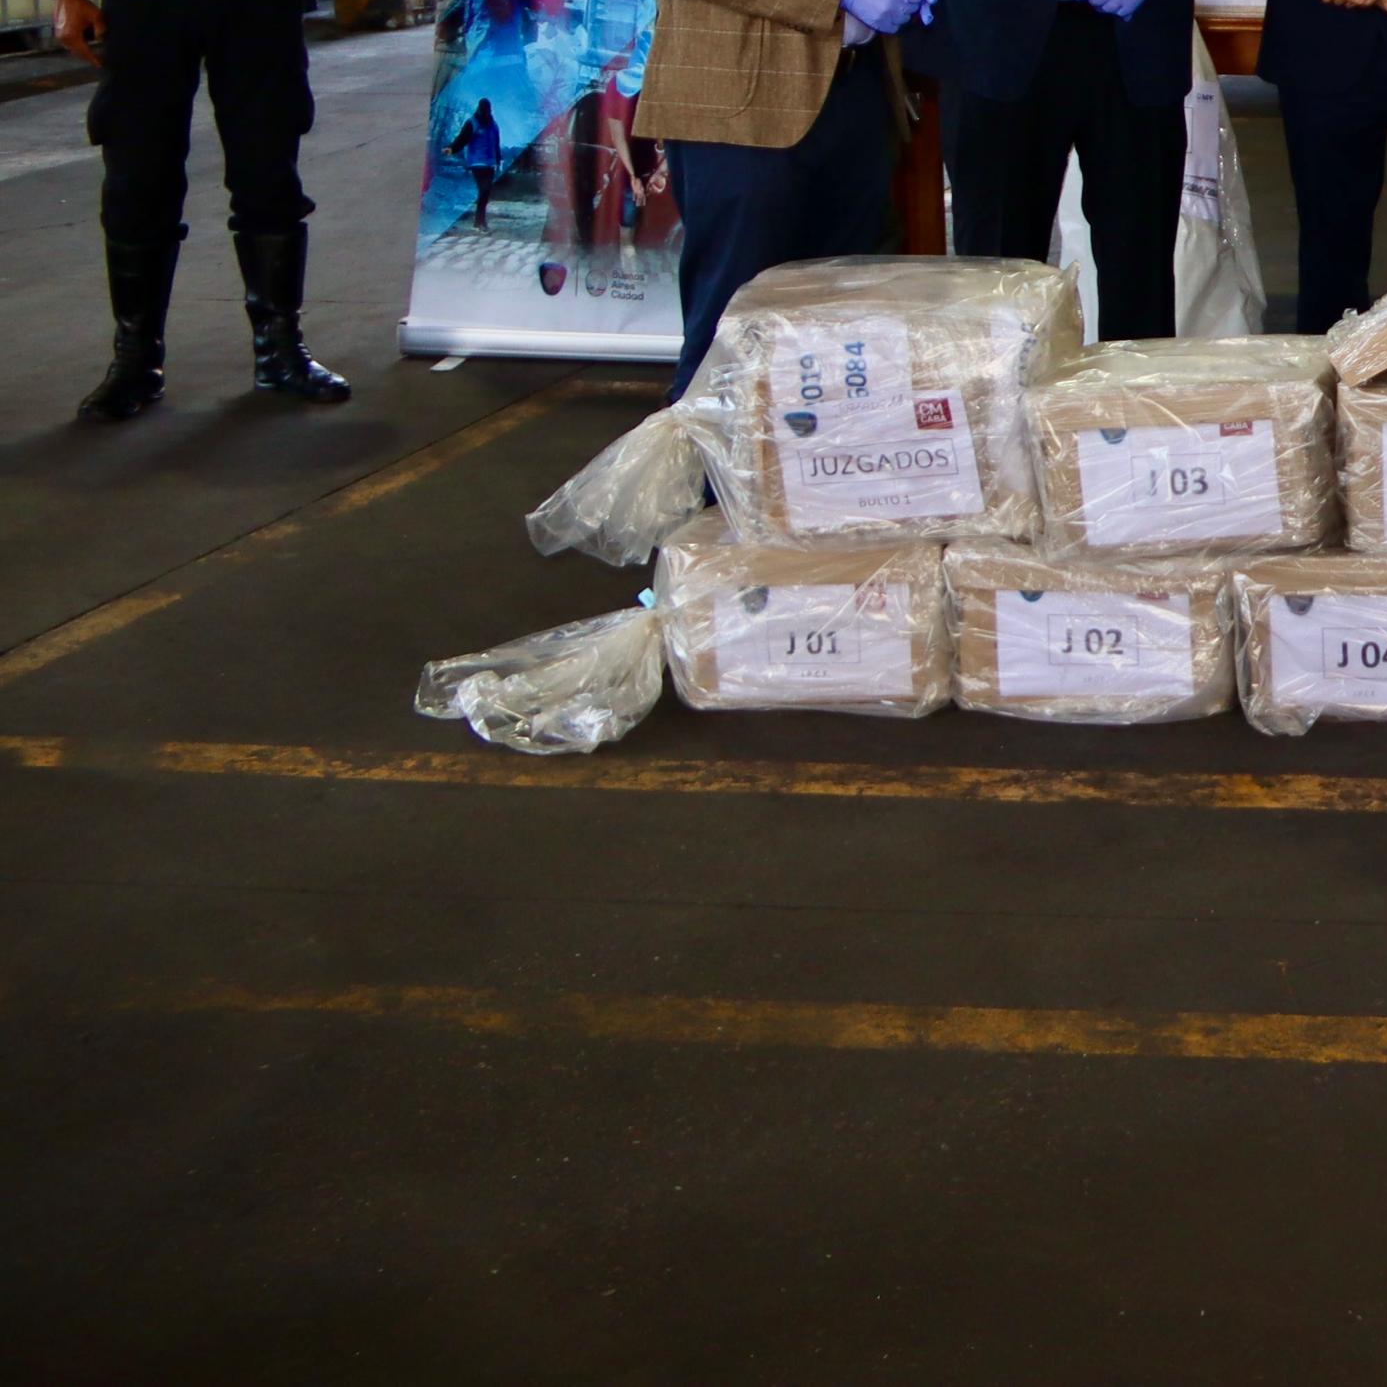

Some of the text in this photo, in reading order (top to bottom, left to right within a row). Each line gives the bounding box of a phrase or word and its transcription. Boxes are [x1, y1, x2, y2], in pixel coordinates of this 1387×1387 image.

[611, 290, 645, 302] Ciudad
[800, 352, 824, 406] 019
[918, 402, 943, 415] CM
[919, 414, 947, 424] CABA
[809, 448, 950, 477] JUZGADOS
[1169, 466, 1210, 495] 03
[858, 494, 900, 508] BULTO
[785, 630, 843, 656] J 01
[1063, 628, 1125, 655] J 02
[1336, 641, 1350, 669] J
